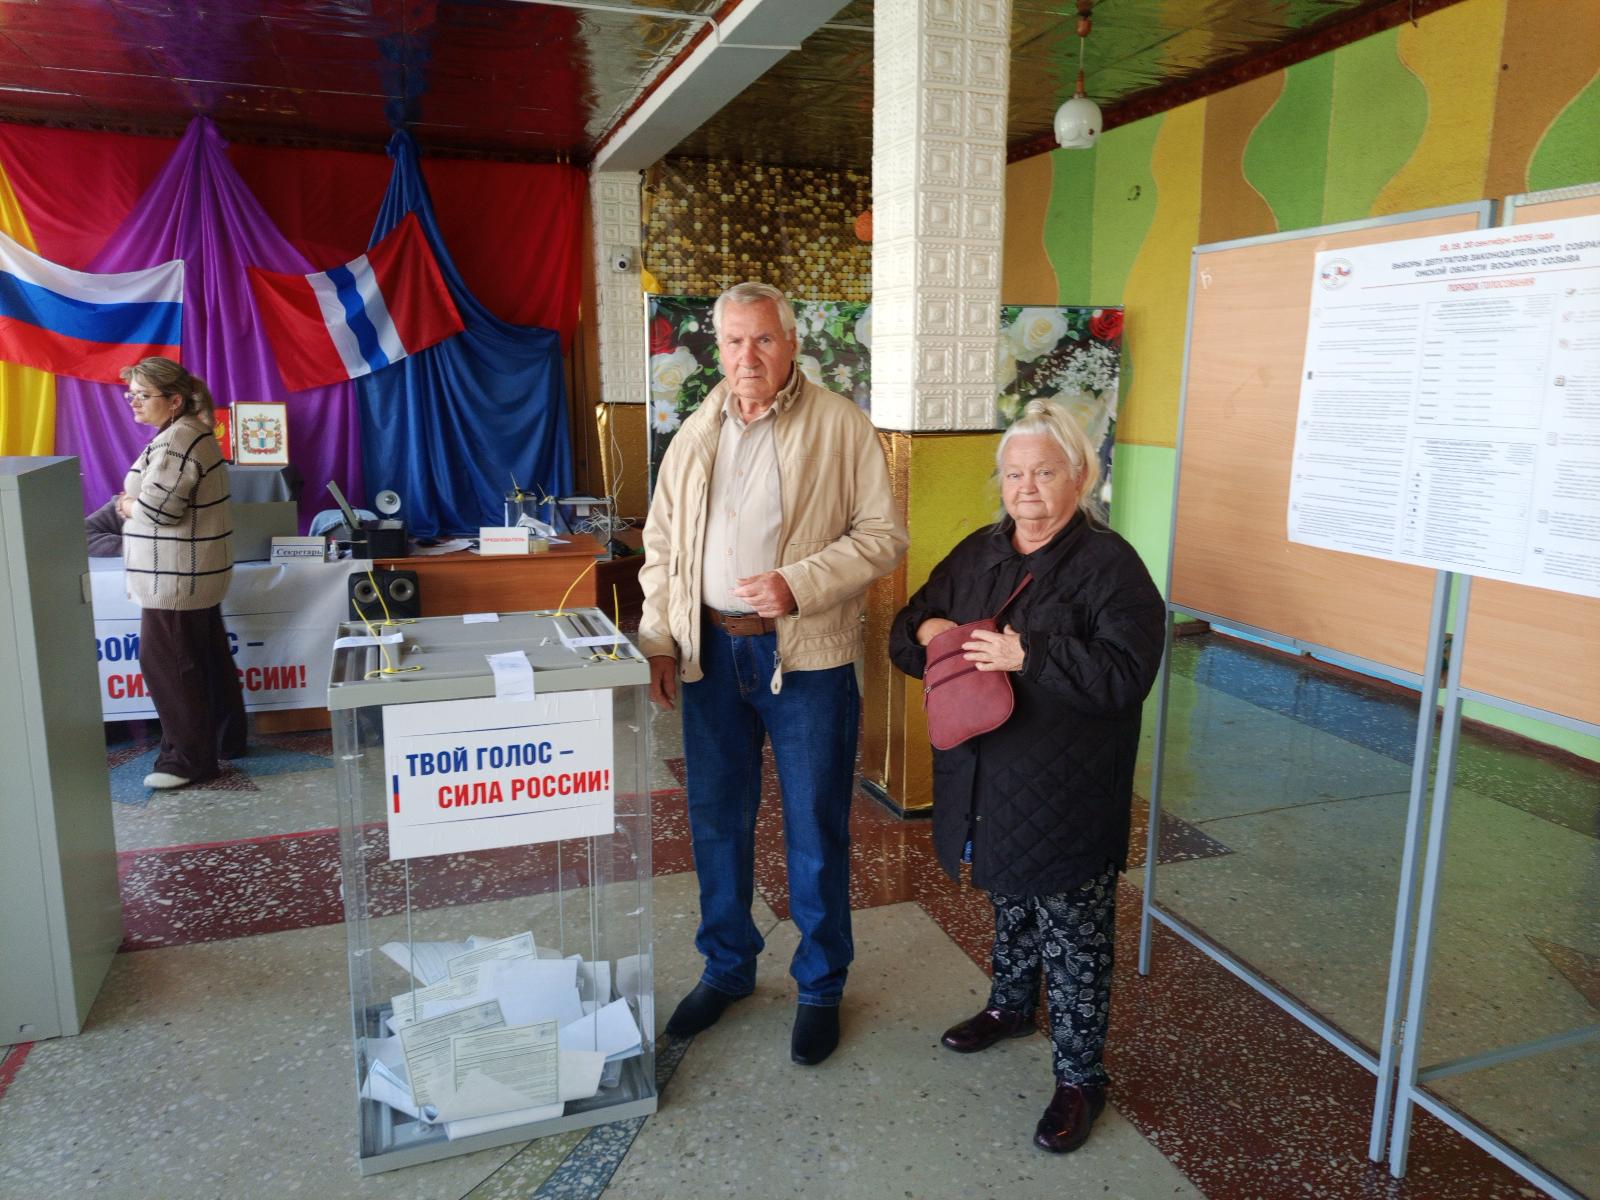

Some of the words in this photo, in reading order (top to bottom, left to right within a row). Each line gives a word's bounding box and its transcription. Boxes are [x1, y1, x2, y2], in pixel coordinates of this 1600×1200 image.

[276, 548, 322, 557] Секретарь
[95, 633, 140, 662] ОЙ
[107, 672, 151, 700] СИ
[234, 664, 307, 692] СИИ!
[406, 747, 468, 777] ТВОЙ
[476, 741, 552, 770] ГОЛОС
[438, 781, 504, 809] СИЛА
[511, 769, 610, 801] РОССИИ!
